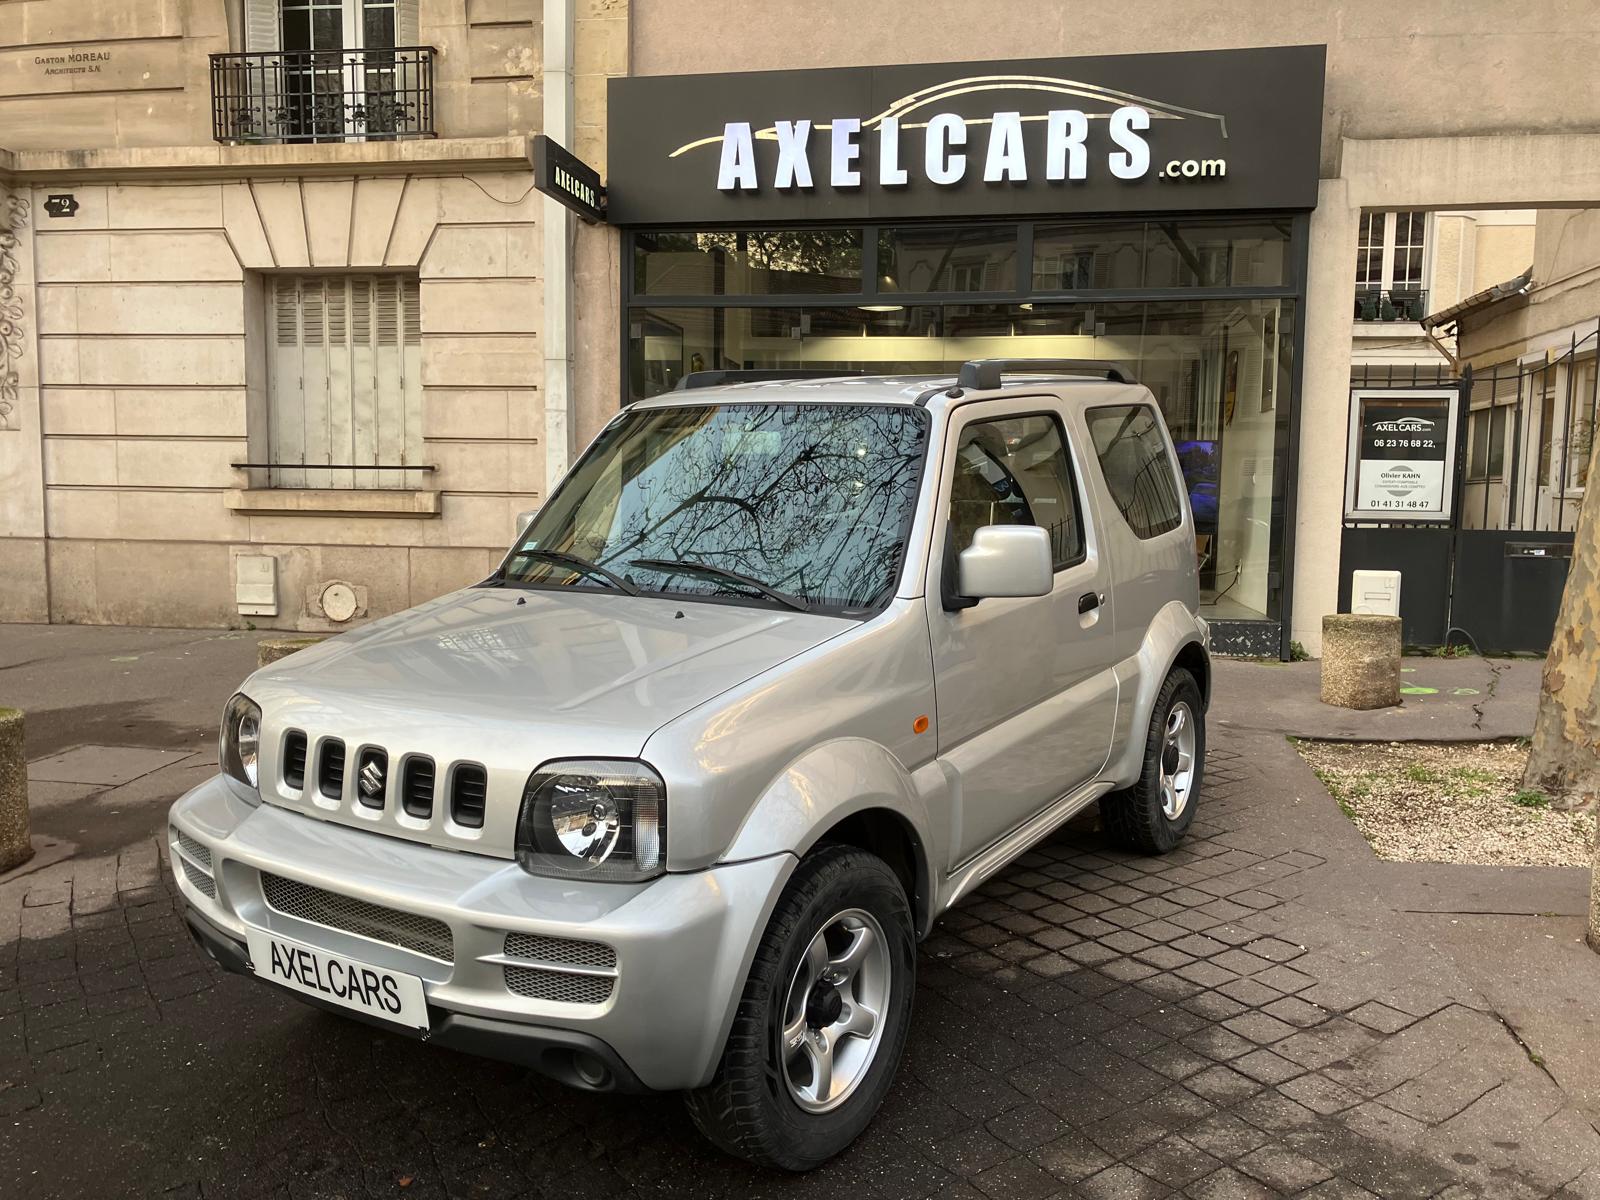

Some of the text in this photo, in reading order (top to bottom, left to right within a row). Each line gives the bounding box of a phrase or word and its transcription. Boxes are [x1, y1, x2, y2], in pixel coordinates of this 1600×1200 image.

[68, 52, 110, 62] MOREAU
[1386, 439, 1397, 447] 23
[271, 941, 402, 1014] AXELCARS
